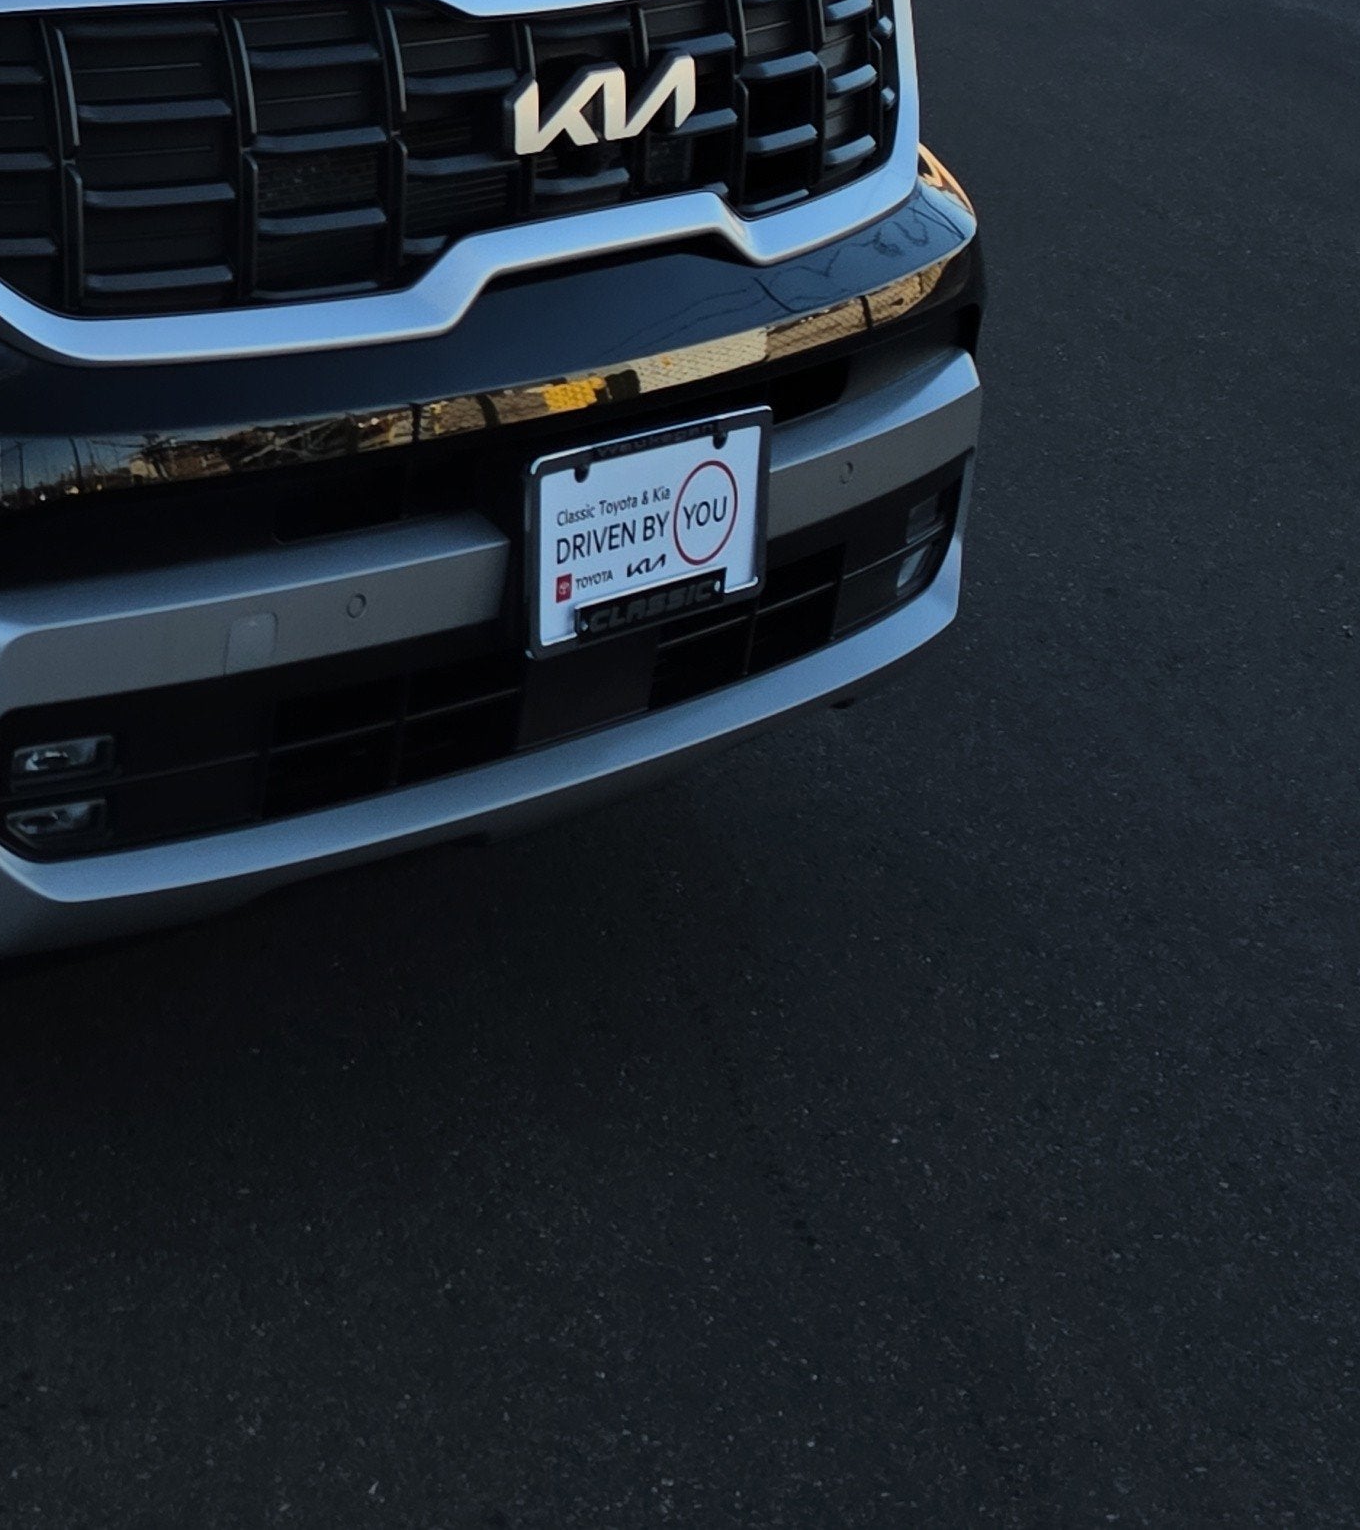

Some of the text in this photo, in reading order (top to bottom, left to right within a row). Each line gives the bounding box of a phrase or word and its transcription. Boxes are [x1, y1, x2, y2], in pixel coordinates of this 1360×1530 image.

[513, 53, 696, 156] KIA
[556, 496, 728, 565] DRIVEN BY YOU
[557, 487, 671, 527] Classic Toyota & Kia
[575, 570, 614, 590] TOYOTA
[626, 553, 667, 578] KIA
[589, 579, 714, 634] CLASSIC
